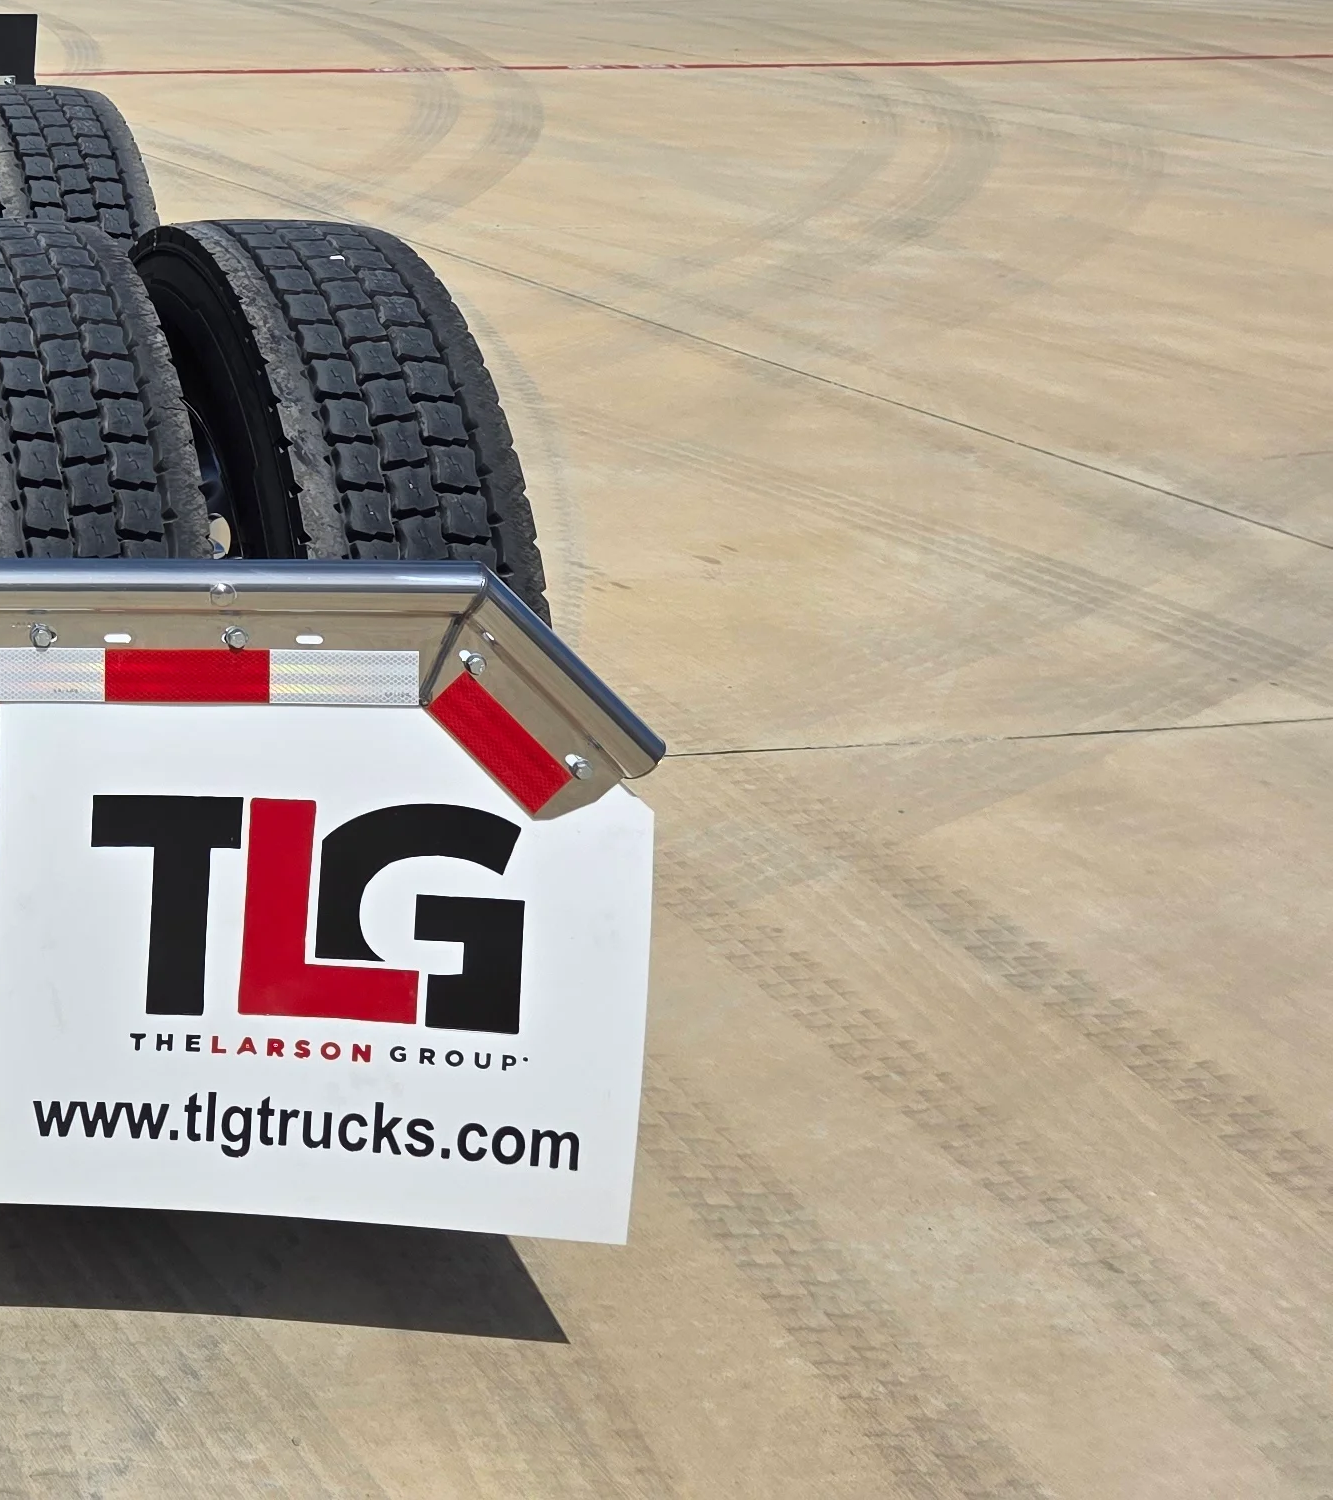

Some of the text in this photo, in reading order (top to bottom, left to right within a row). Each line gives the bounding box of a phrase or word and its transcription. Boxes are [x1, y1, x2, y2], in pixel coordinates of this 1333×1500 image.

[91, 794, 526, 1034] TLG
[389, 1045, 518, 1072] GROUP
[32, 1091, 580, 1172] www.tlgtrucks.com
